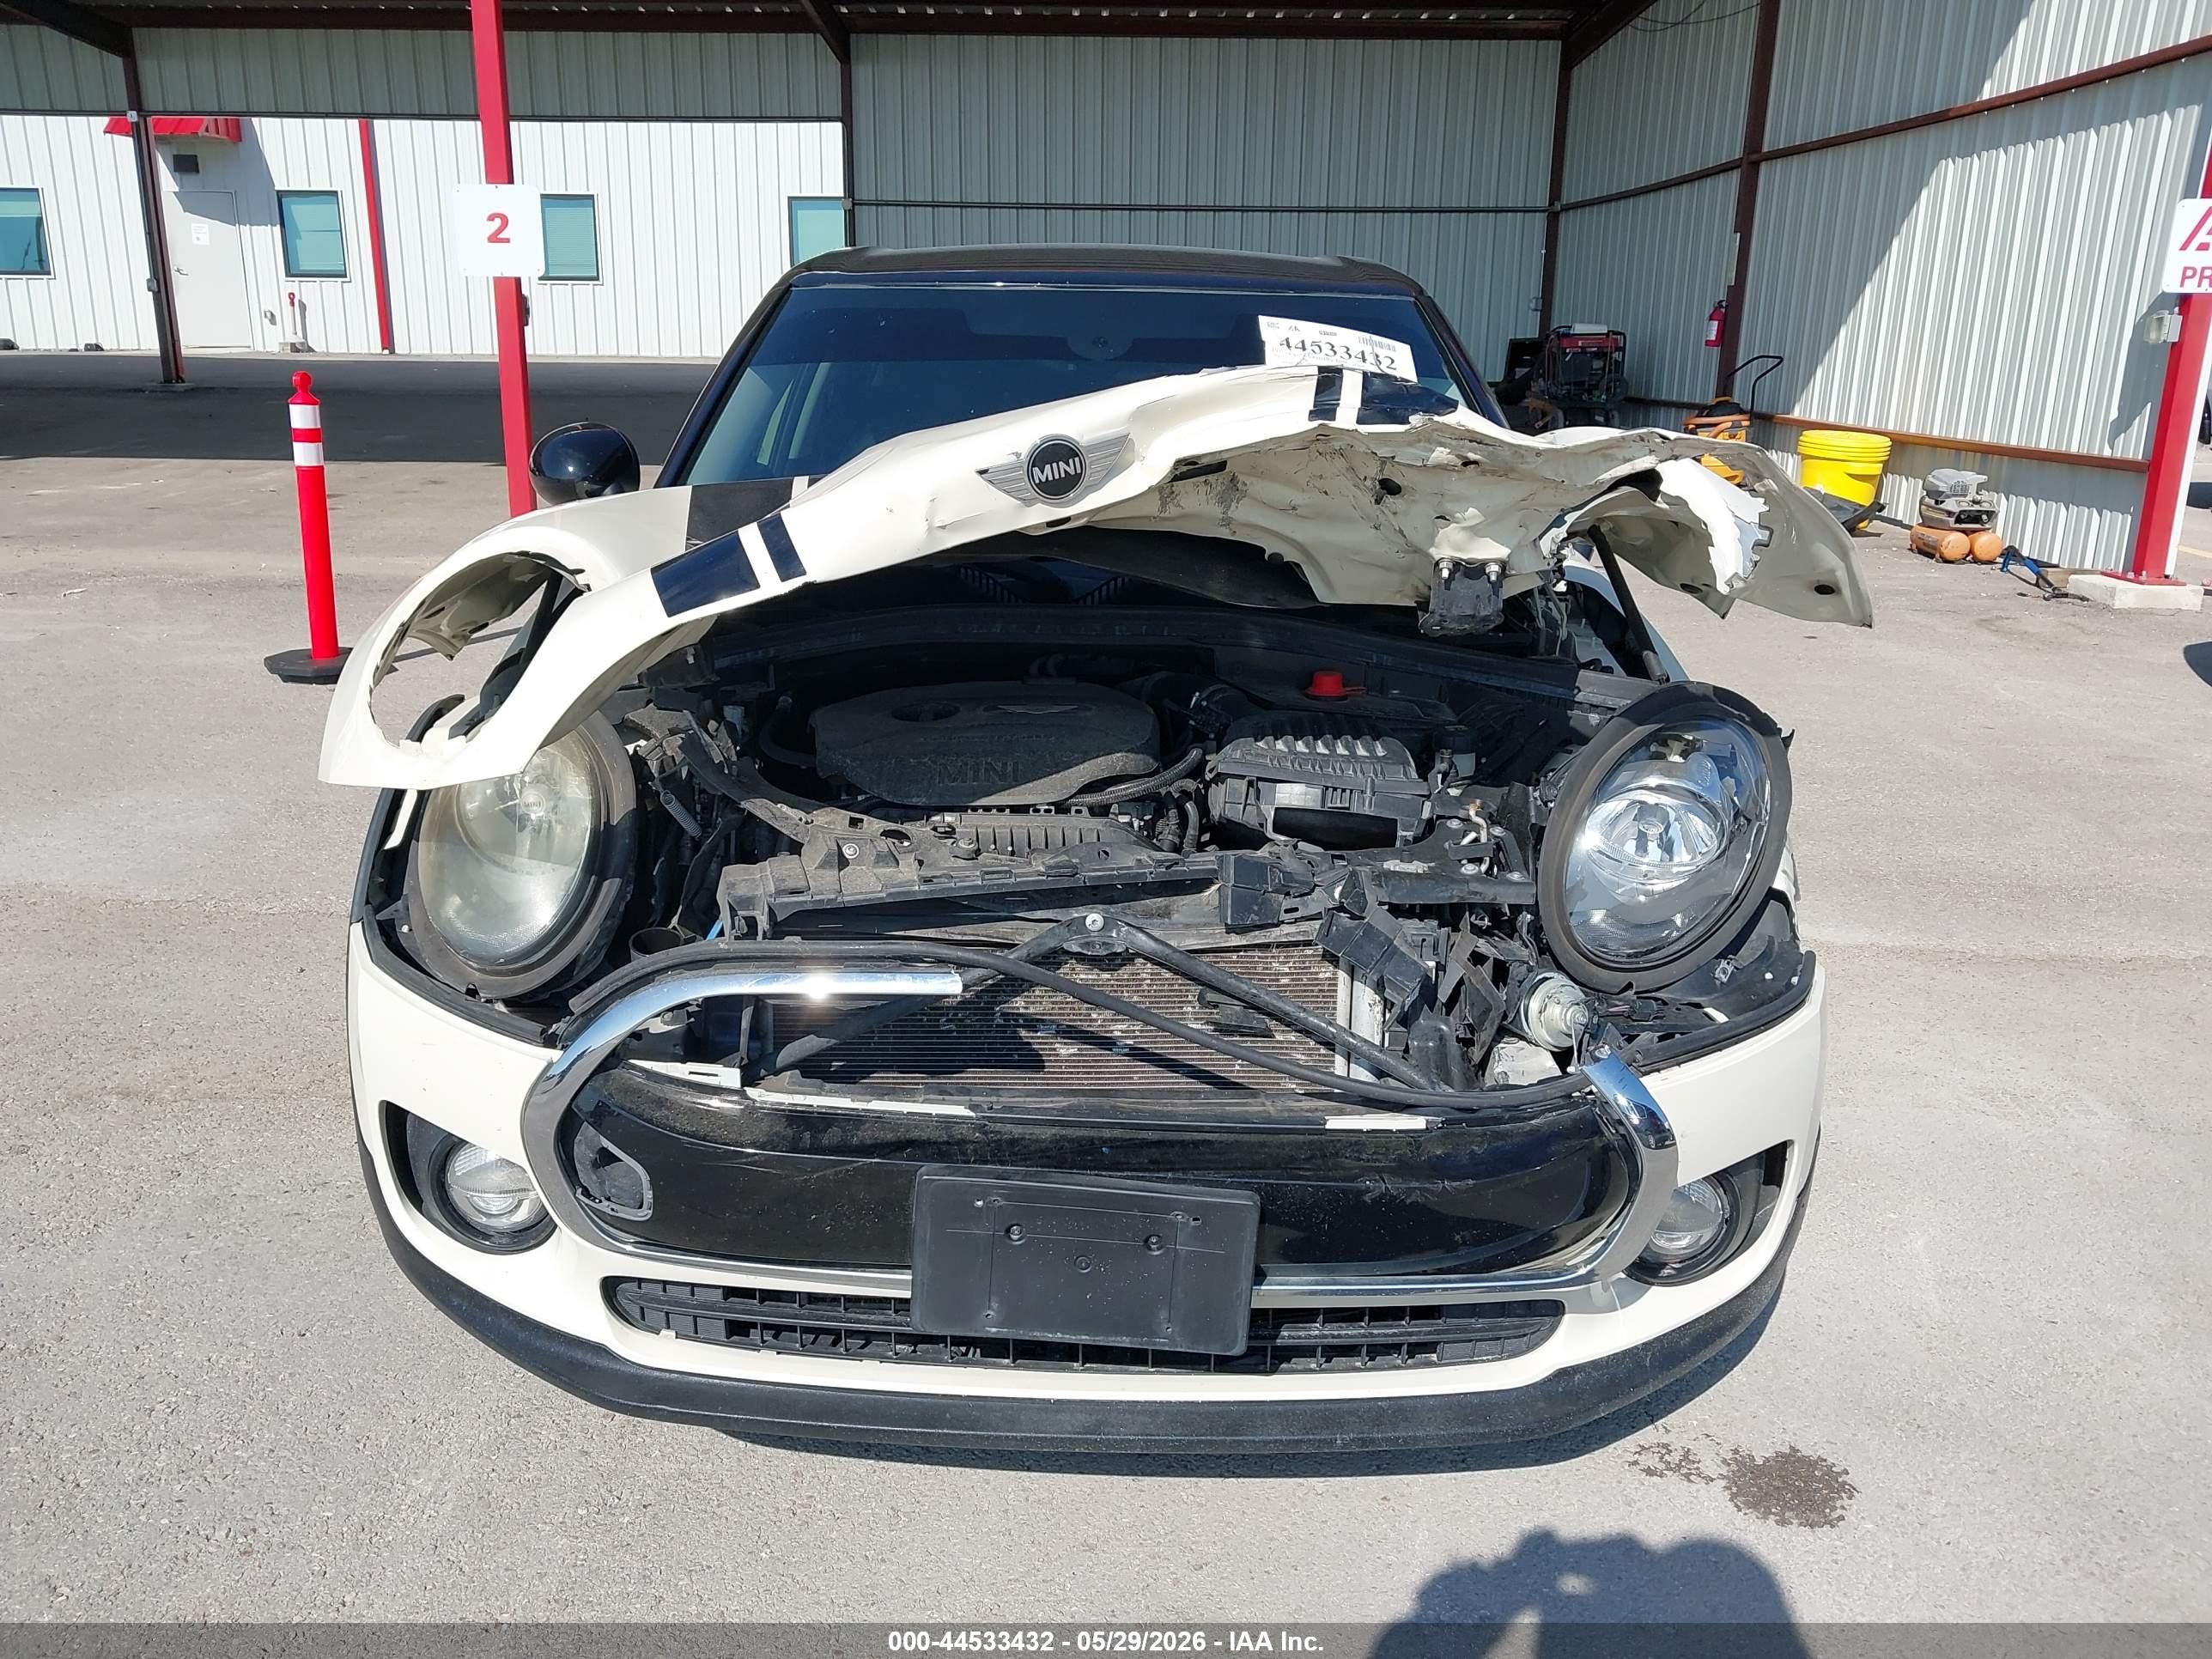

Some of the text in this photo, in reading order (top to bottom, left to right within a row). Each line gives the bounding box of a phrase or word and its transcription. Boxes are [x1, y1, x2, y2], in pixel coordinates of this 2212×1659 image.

[486, 212, 511, 244] 2
[1279, 336, 1398, 371] 44533432
[1032, 456, 1082, 484] MINI
[937, 760, 1022, 786] MINI
